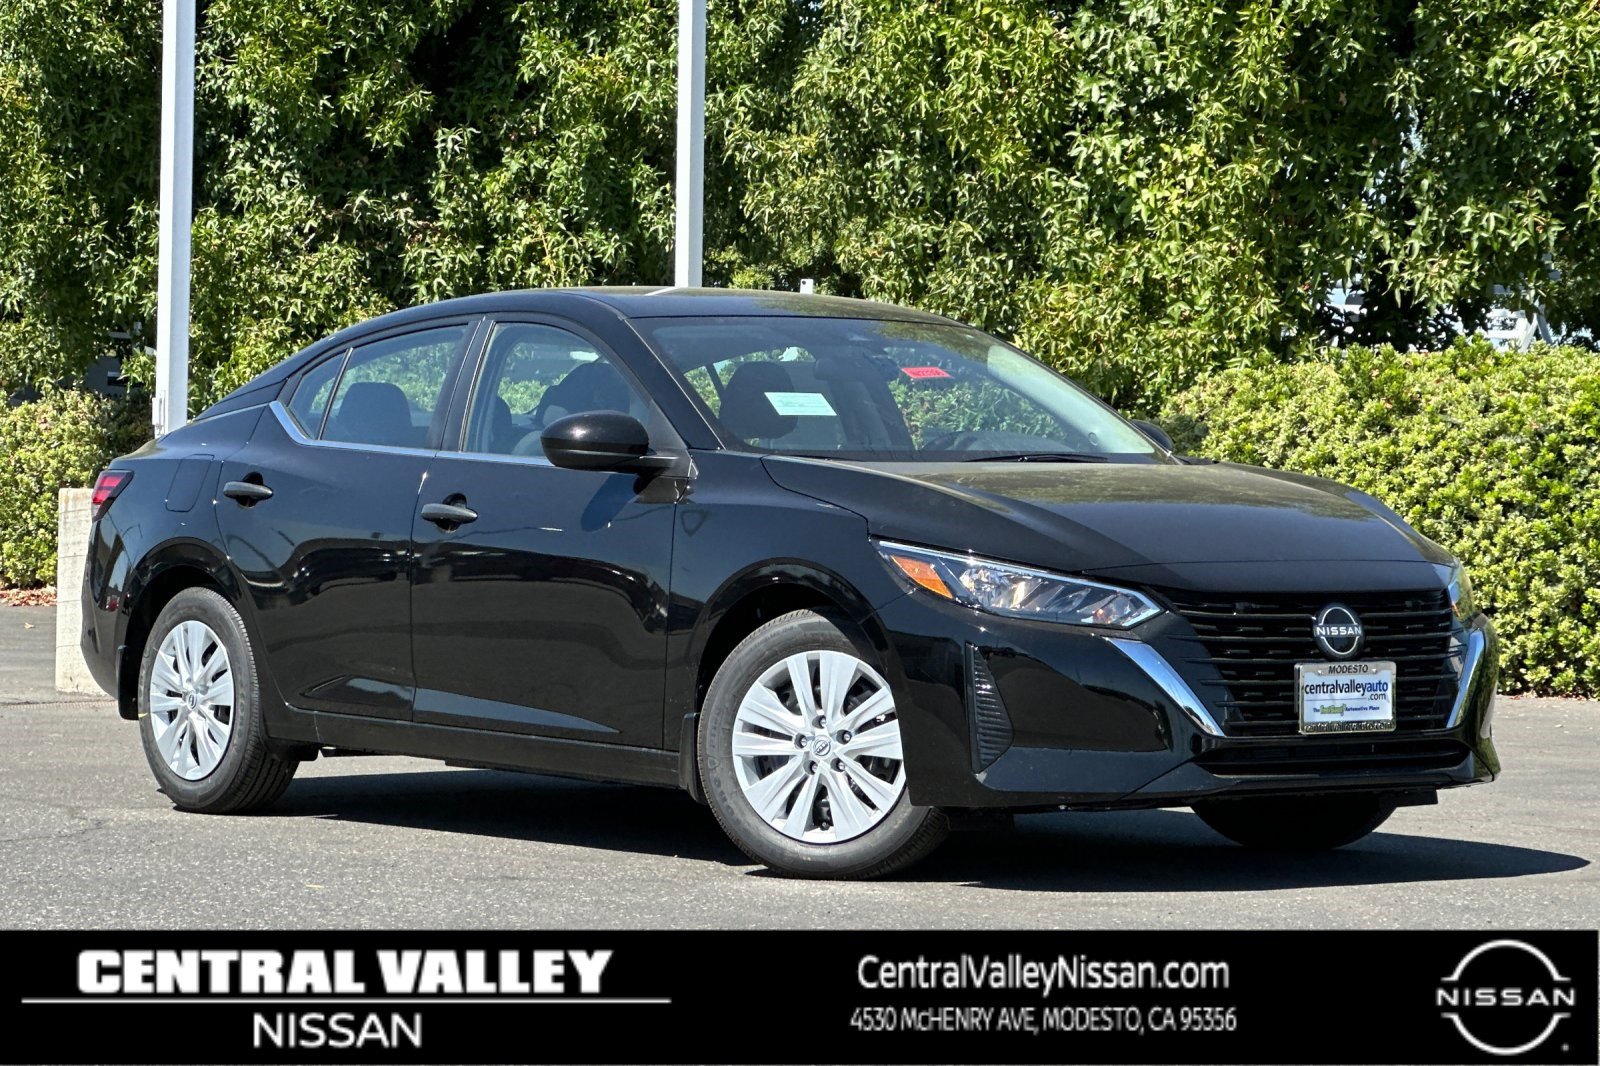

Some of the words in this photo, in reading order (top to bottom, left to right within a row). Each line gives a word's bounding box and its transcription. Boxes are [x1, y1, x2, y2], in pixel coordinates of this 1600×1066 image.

[1316, 626, 1362, 636] NISSAN
[1328, 664, 1369, 674] MODESTO
[1304, 679, 1389, 697] centralvalleyauto
[1367, 693, 1387, 701] .com
